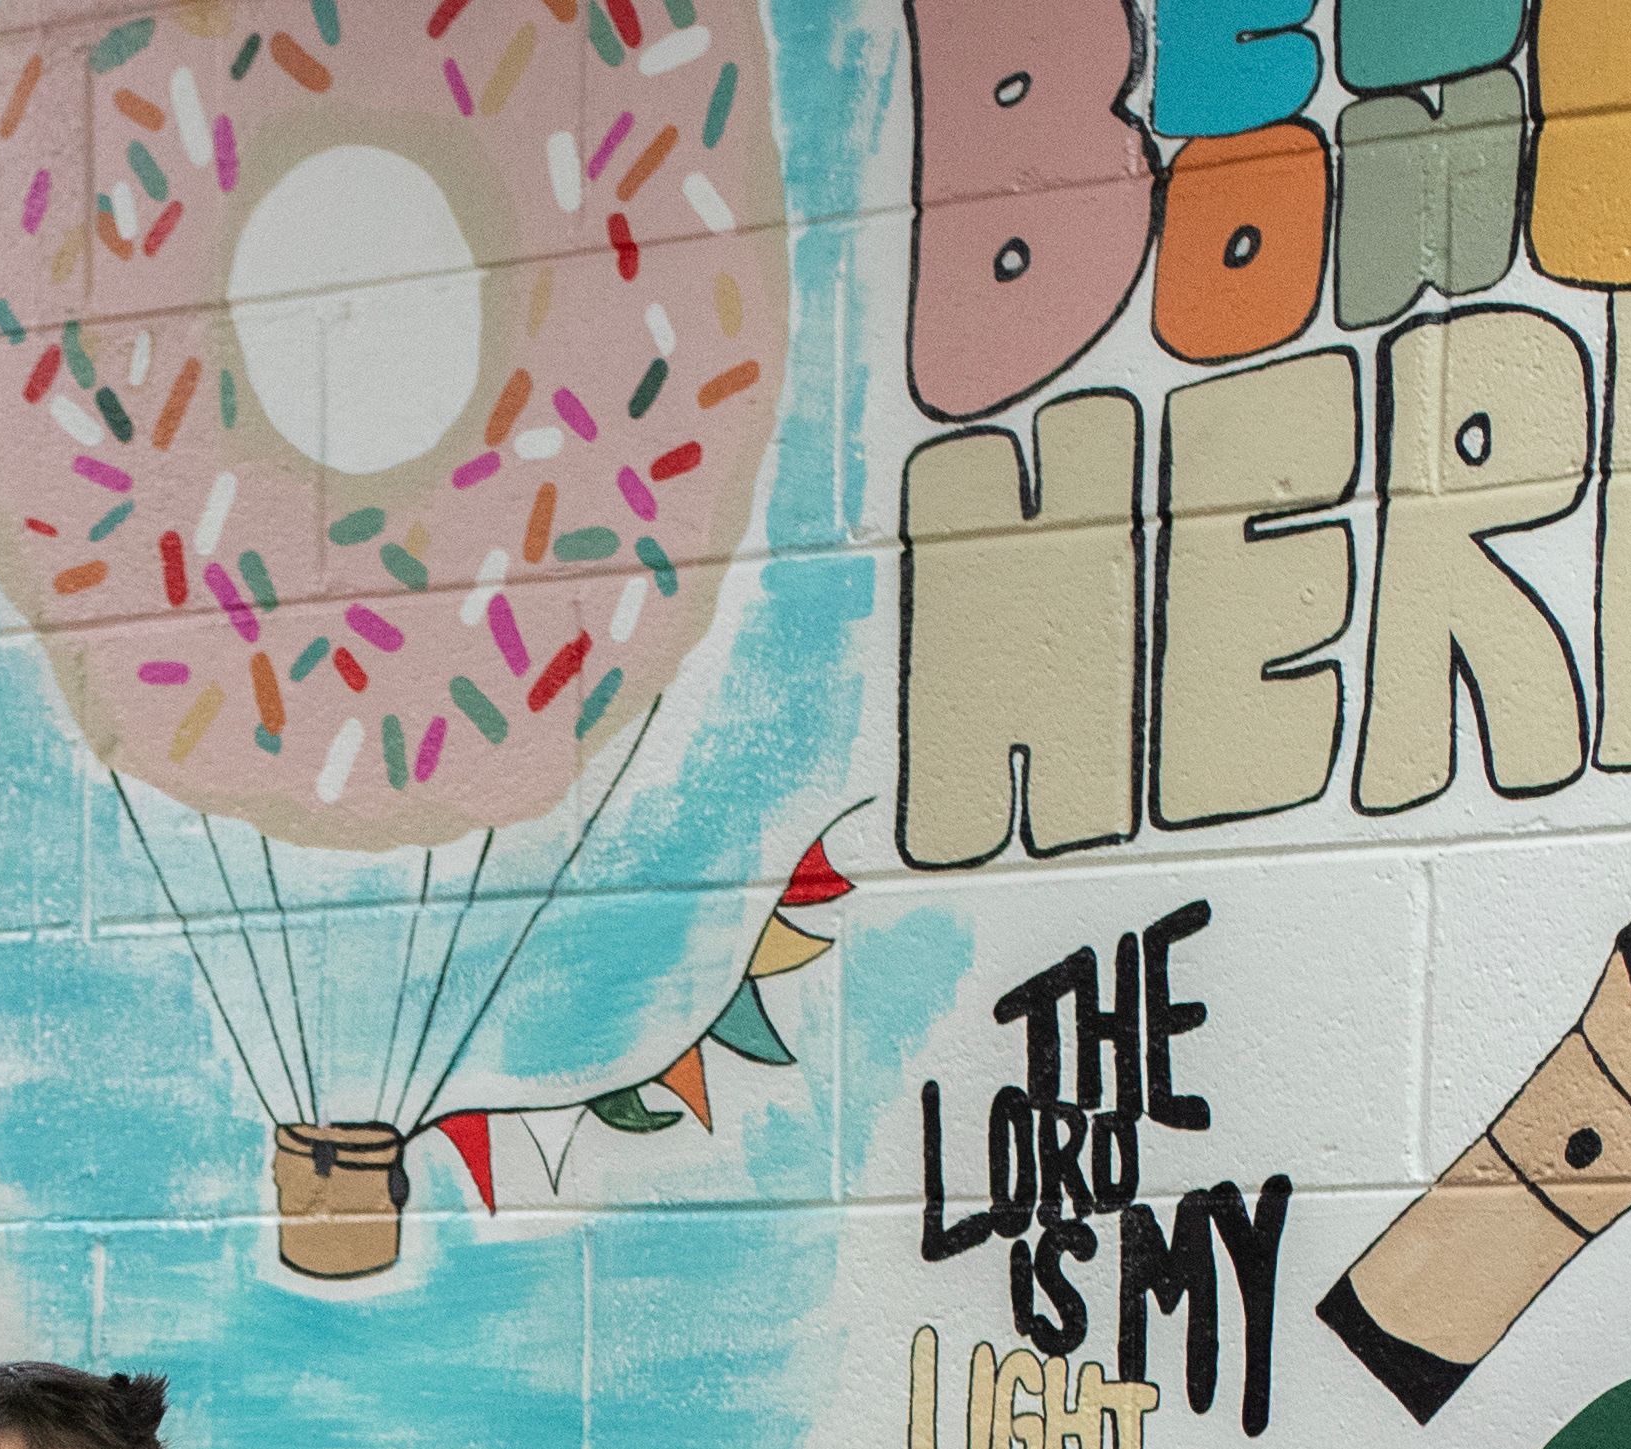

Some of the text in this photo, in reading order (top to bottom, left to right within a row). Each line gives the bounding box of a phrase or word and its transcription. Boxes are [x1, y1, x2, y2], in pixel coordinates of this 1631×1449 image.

[993, 900, 1211, 1130] THE
[922, 1080, 1140, 1261] LORD
[1010, 1174, 1293, 1437] IS MY
